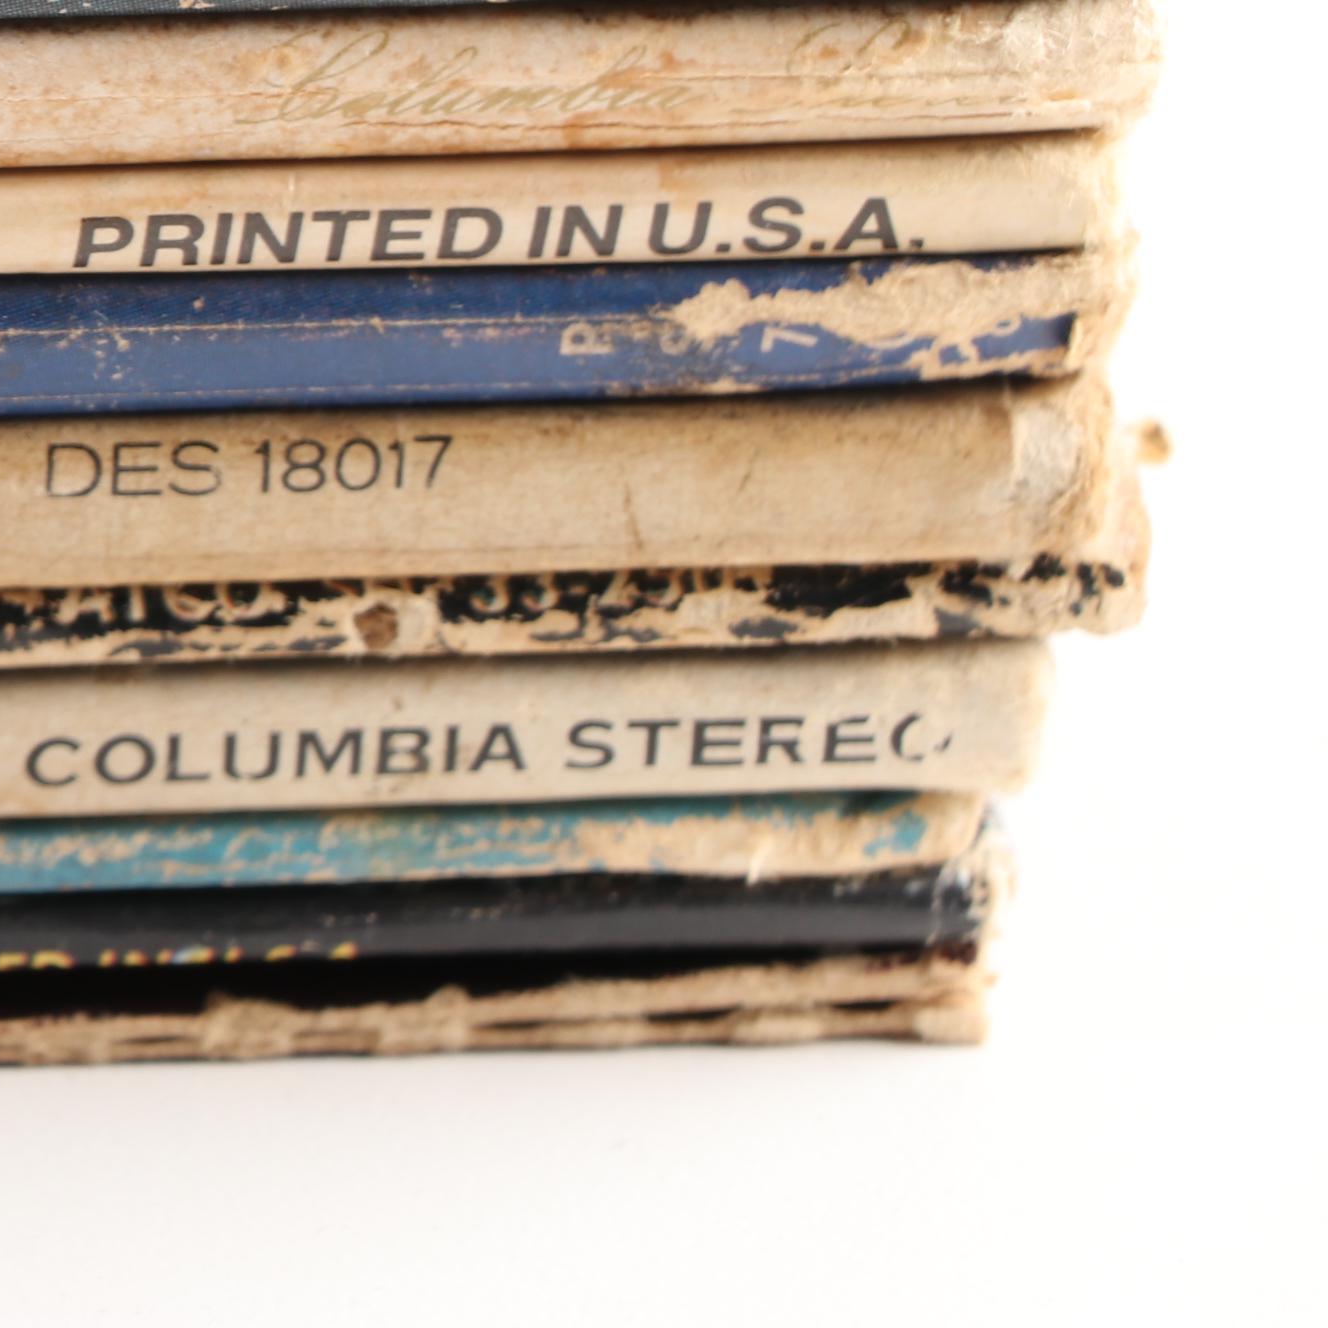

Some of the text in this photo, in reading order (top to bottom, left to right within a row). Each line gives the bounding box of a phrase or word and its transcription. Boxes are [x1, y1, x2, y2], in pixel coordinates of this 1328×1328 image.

[236, 28, 706, 126] Columbia
[74, 207, 504, 268] PRINTED
[527, 203, 624, 259] IN
[645, 196, 927, 255] U.S.A.
[45, 440, 223, 498] DES
[255, 434, 454, 495] 18017
[25, 718, 528, 788] COLUMBIA
